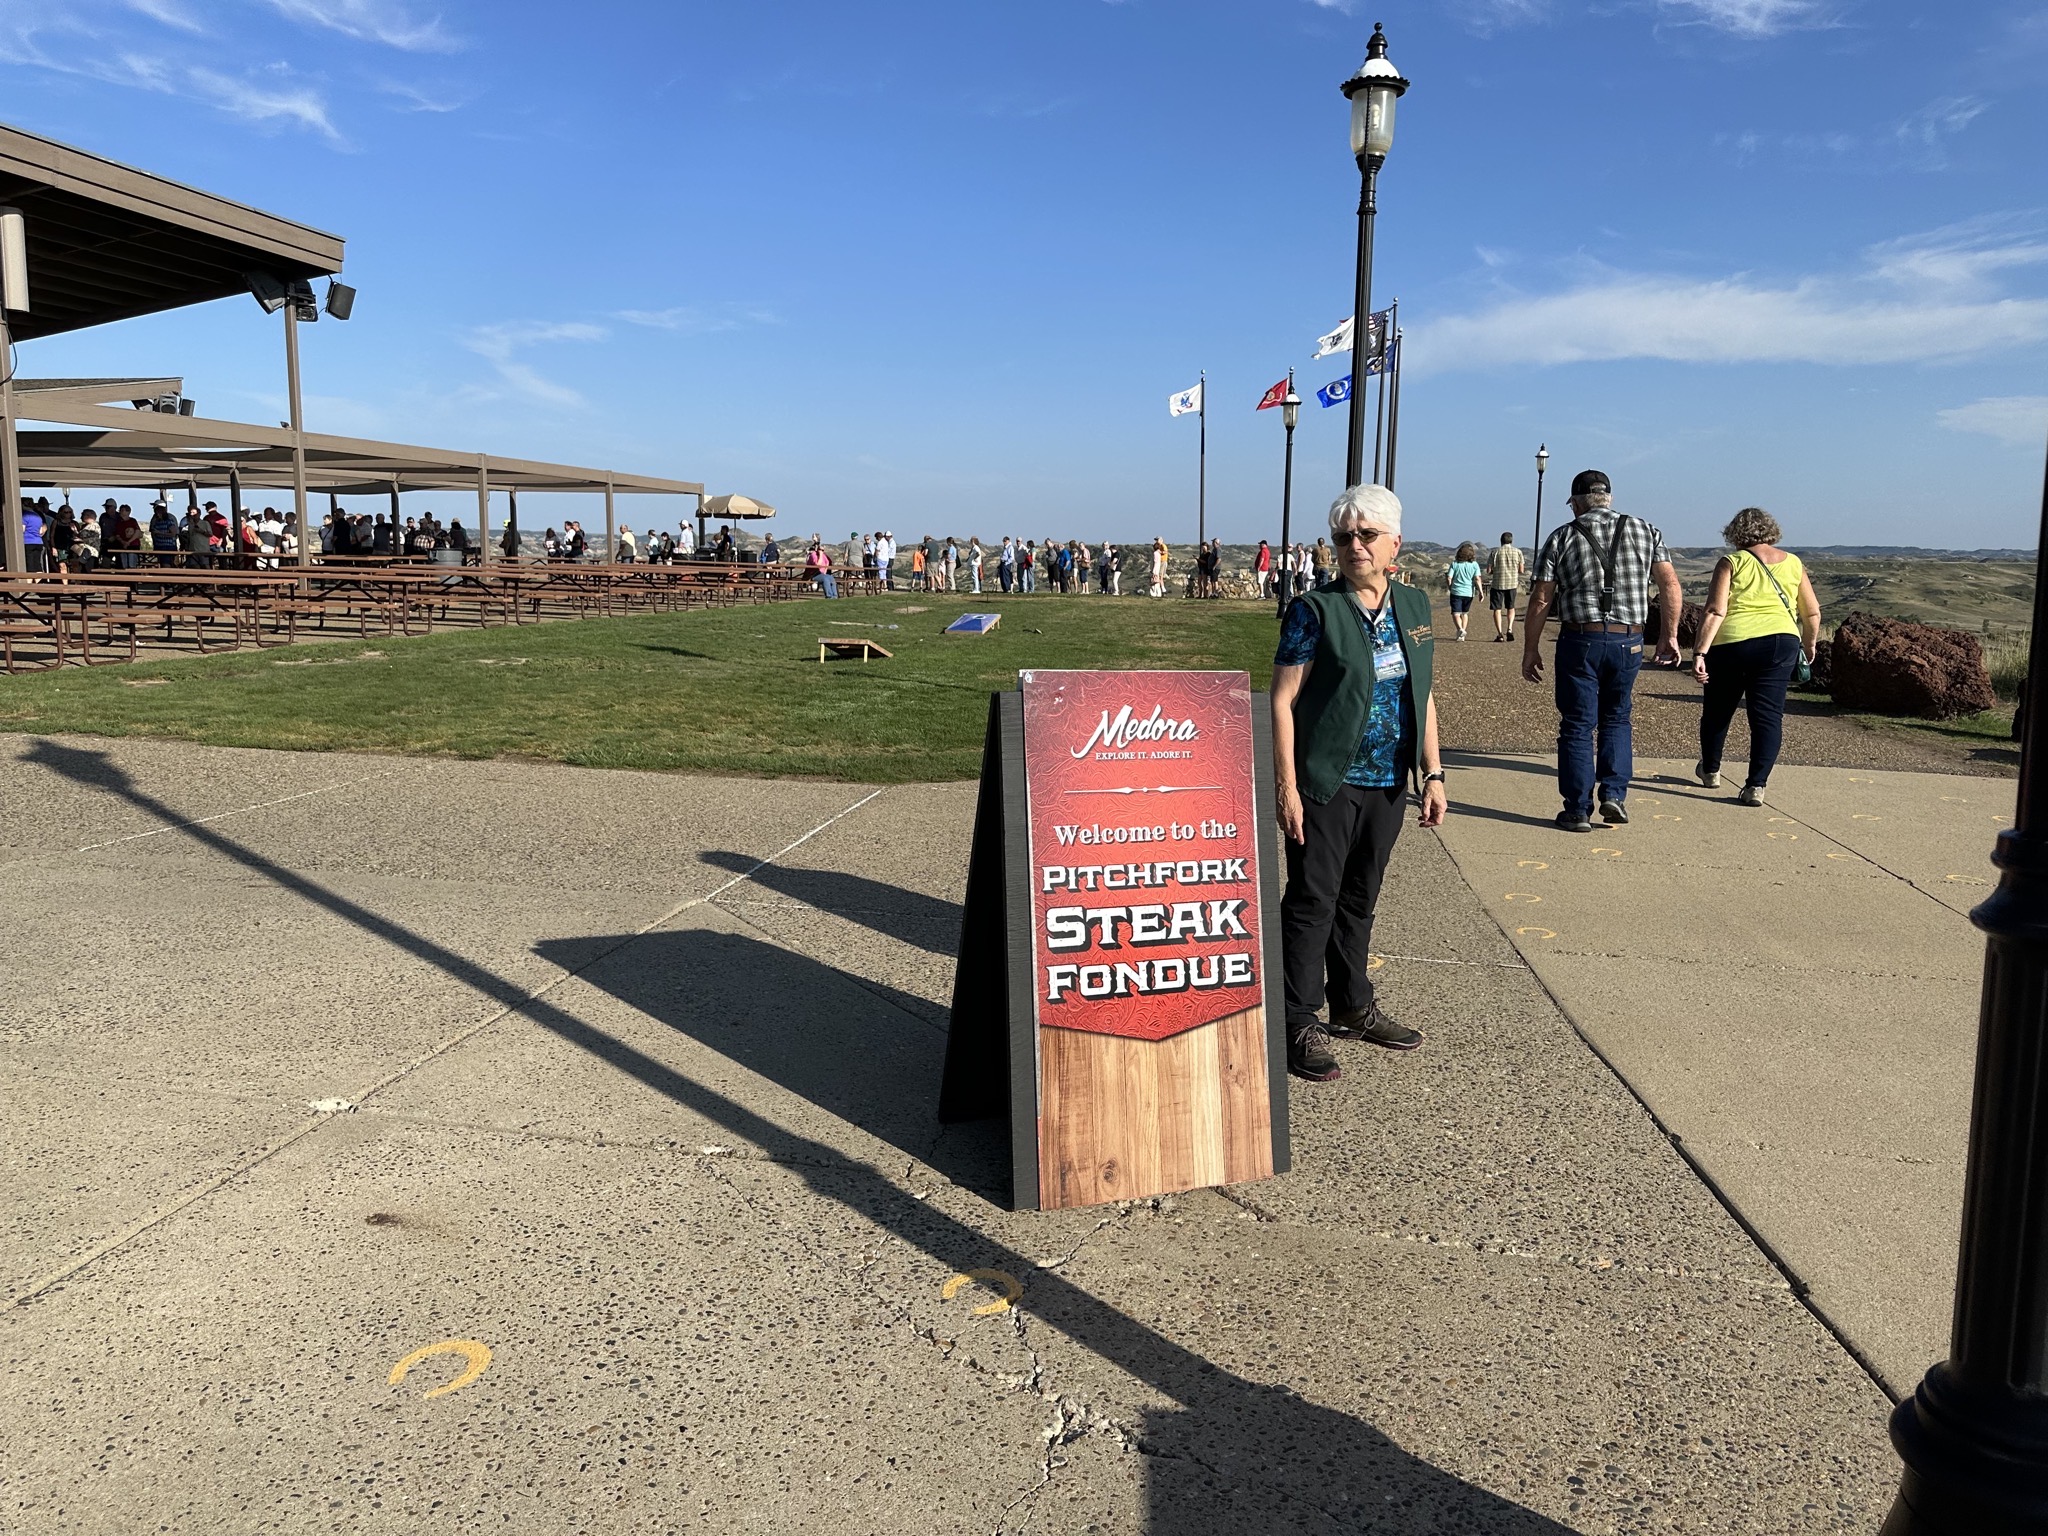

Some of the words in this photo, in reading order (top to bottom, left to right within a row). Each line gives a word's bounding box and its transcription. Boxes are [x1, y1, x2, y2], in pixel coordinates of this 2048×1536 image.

[1071, 704, 1200, 758] Medora
[1096, 752, 1136, 760] EXPLORE
[1138, 751, 1149, 759] IT.
[1151, 751, 1181, 759] ADORE
[1183, 751, 1193, 759] IT.
[1053, 822, 1165, 846] Welcome
[1169, 821, 1196, 840] to
[1201, 818, 1237, 839] the
[1042, 858, 1250, 893] PITCHFORK
[1046, 899, 1252, 953] STEAK
[1046, 952, 1254, 1003] FONDUE
